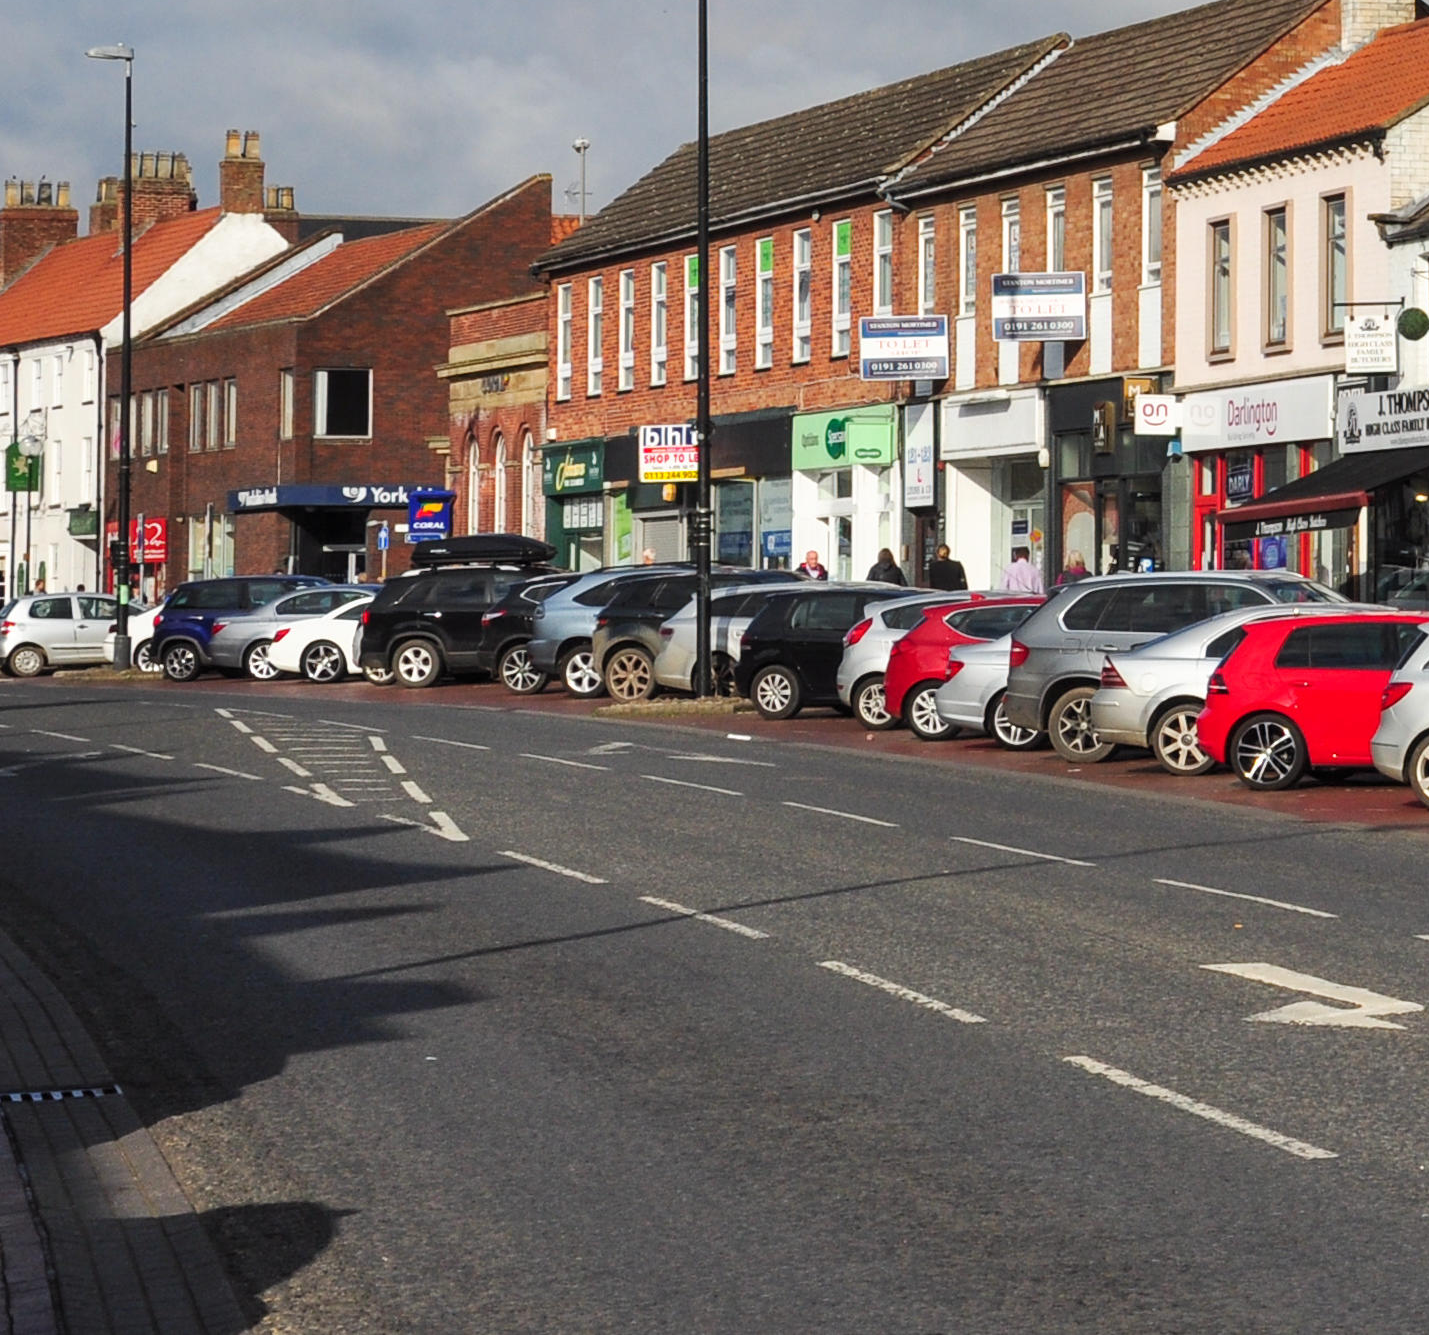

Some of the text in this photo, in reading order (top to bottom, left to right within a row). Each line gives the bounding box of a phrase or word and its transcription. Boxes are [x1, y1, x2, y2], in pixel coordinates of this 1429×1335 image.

[1003, 321, 1028, 331] 0191
[1030, 321, 1048, 330] 261
[879, 339, 929, 349] TO LET
[871, 362, 894, 371] 0191
[896, 362, 913, 371] 261
[1227, 397, 1278, 432] Darlington
[1365, 421, 1381, 437] HIGH
[1382, 420, 1400, 436] CLASS
[1402, 417, 1425, 434] FAMILY
[644, 453, 699, 464] SHOP TO LE
[643, 472, 664, 480] 0113
[666, 471, 681, 480] 244
[413, 521, 445, 529] CORAL
